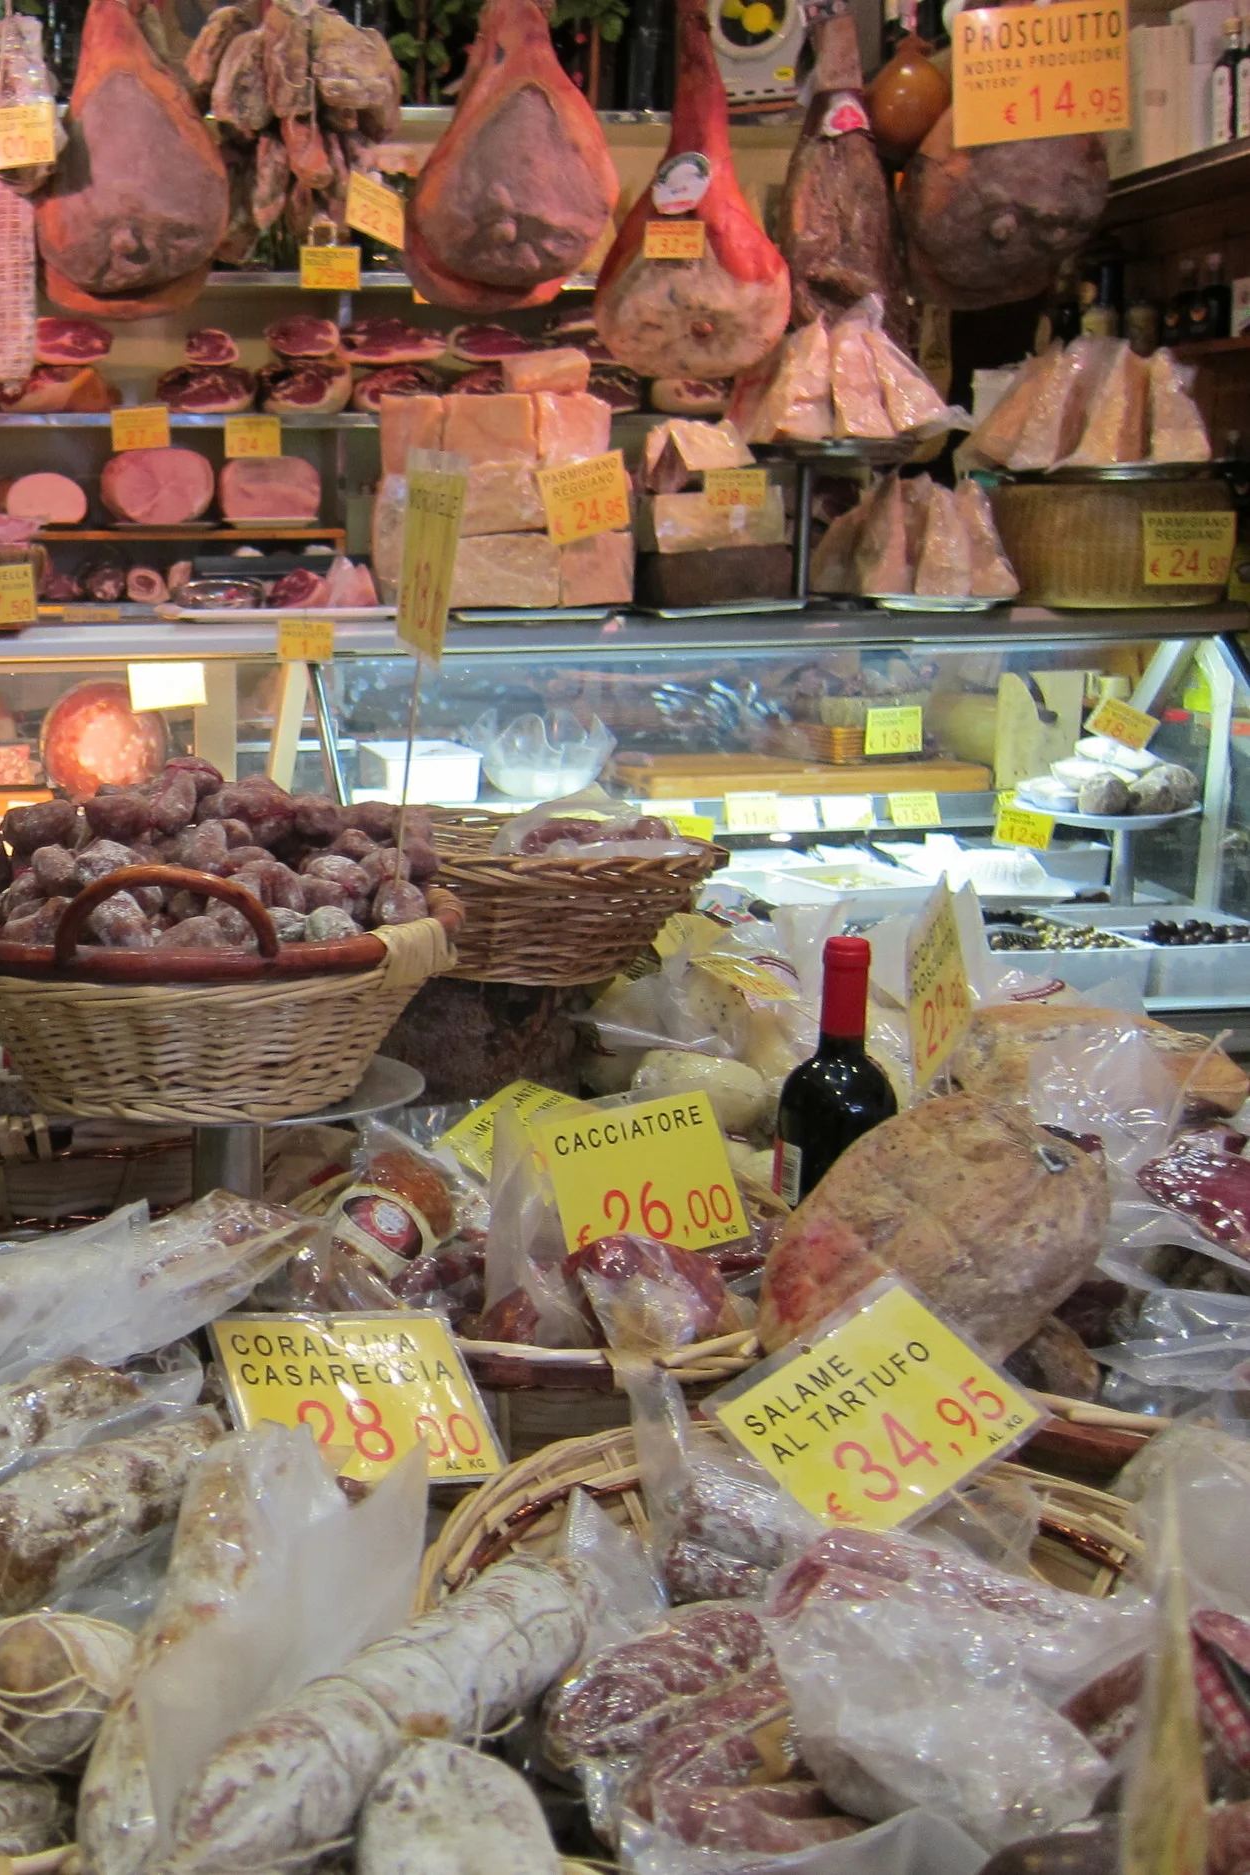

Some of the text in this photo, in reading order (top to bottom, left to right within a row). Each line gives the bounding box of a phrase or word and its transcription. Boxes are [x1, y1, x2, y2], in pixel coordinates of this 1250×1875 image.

[964, 10, 1122, 54] PROSCIUTTO
[964, 46, 1122, 76] NOSTRA PRODUZIONE
[543, 456, 619, 487] PARMIGIANO
[552, 471, 615, 497] REGGIANO
[1147, 517, 1231, 528] PARMIGIANO
[1155, 529, 1222, 540] REGGIANO
[554, 1105, 704, 1156] CACCIATORE
[577, 1181, 734, 1250] €26,00
[709, 1225, 739, 1240] AL KG
[230, 1333, 418, 1358] CORALLINA
[743, 1354, 854, 1437] SALAME
[769, 1340, 931, 1465] AL TARTUFO
[987, 1413, 1024, 1446] AL KG
[446, 1457, 487, 1471] AL KG
[825, 1376, 1007, 1523] €34,95
